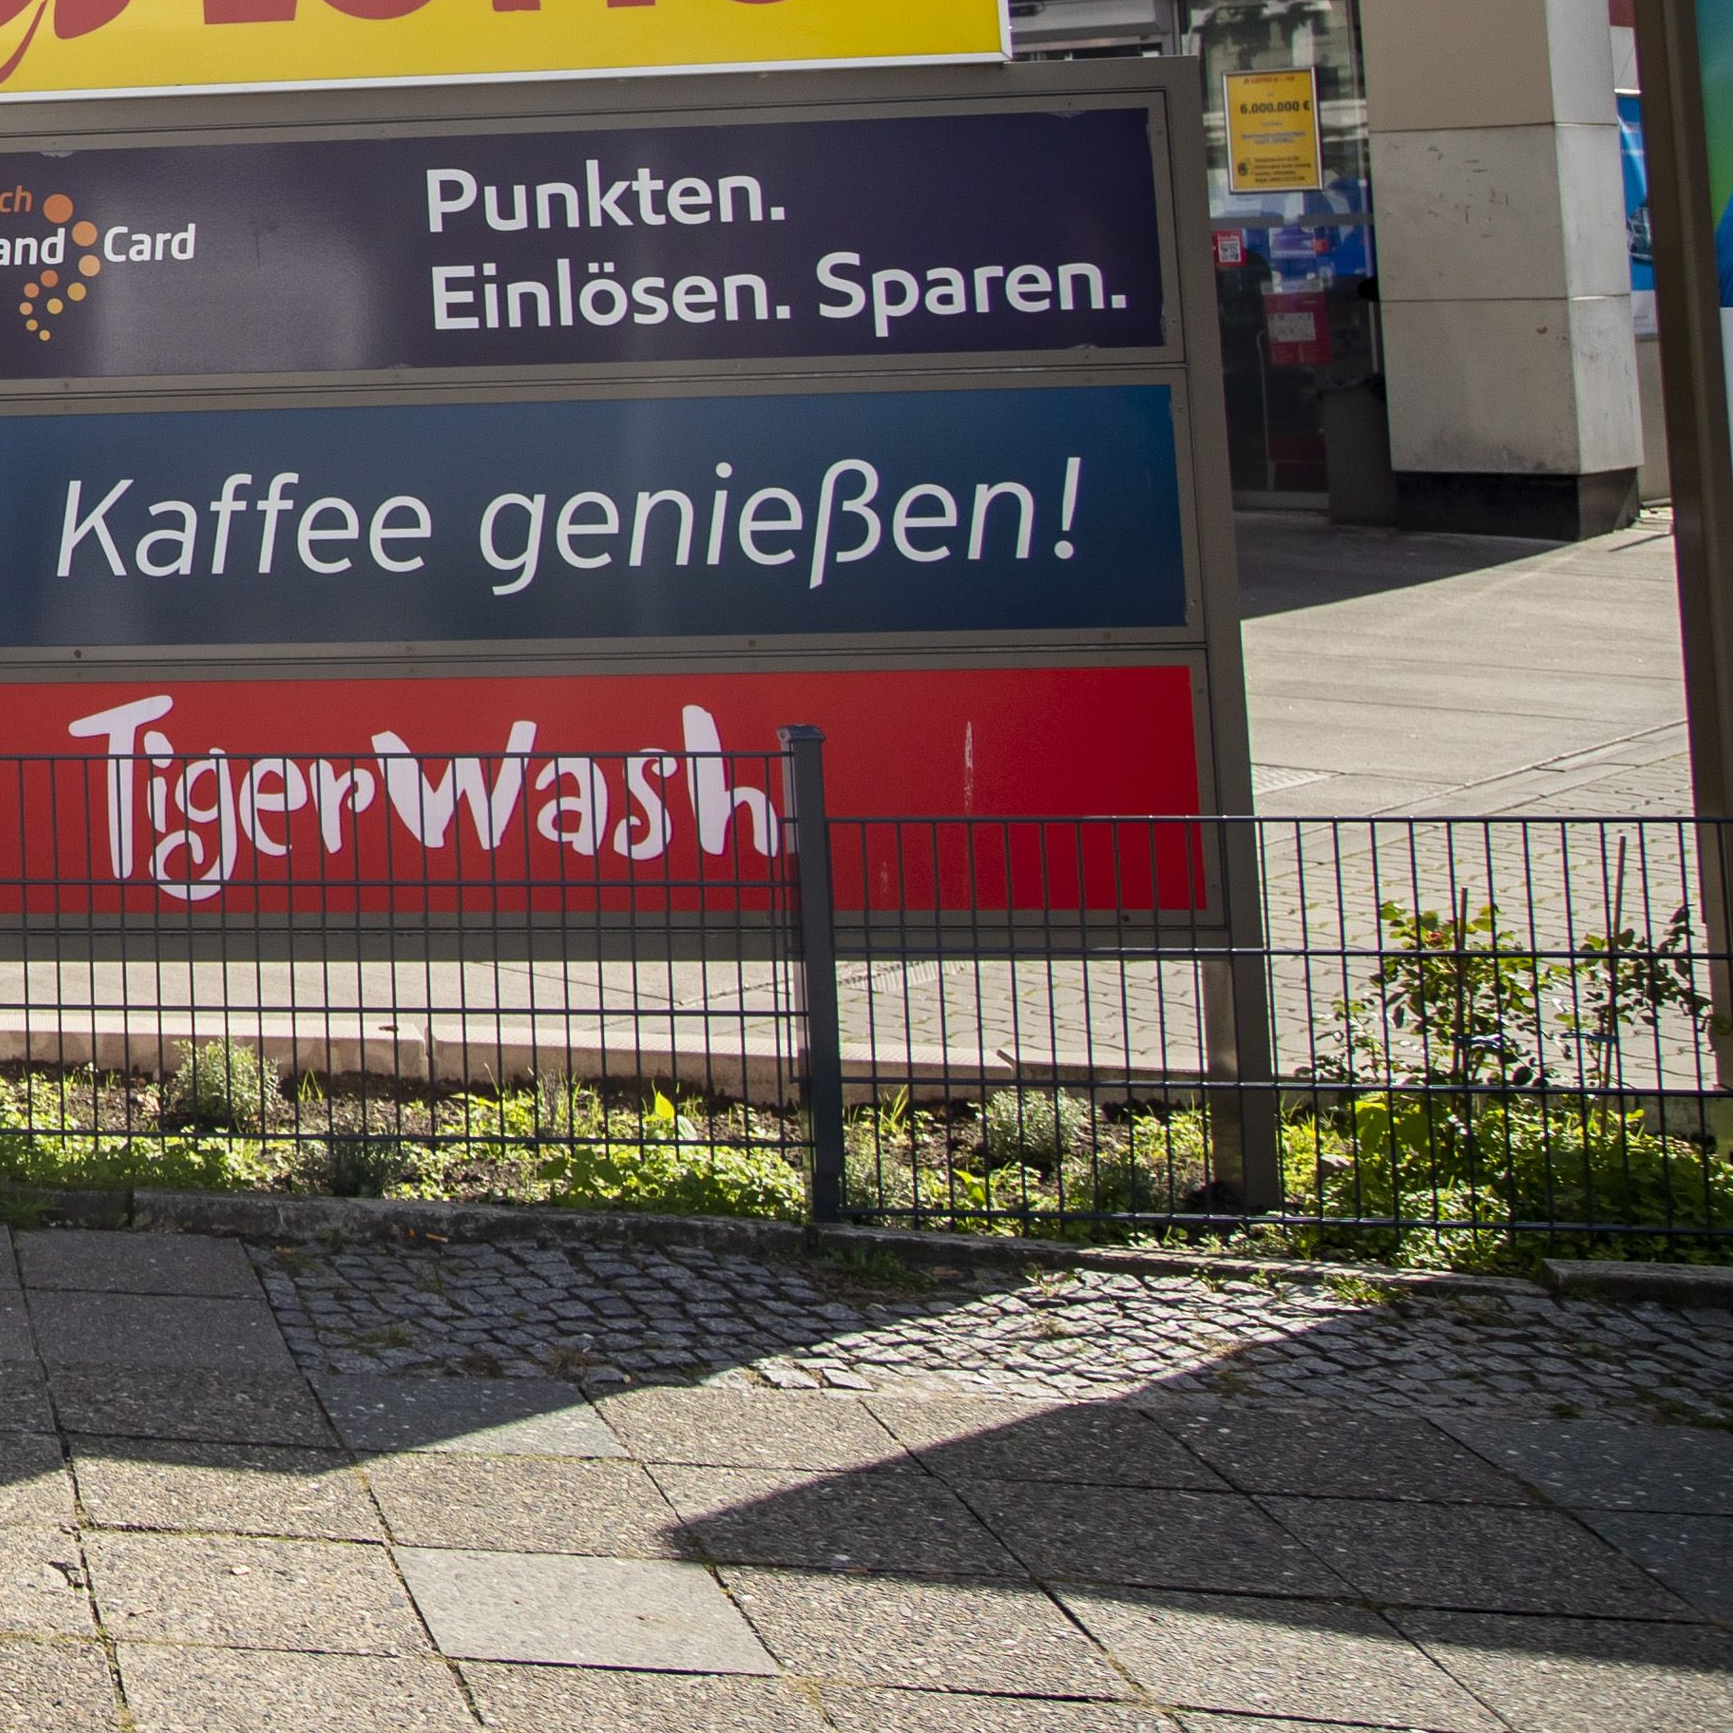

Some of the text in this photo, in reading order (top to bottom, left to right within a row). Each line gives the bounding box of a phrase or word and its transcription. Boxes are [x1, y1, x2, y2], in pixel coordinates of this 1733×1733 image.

[425, 158, 786, 234] Punkten.
[102, 223, 198, 264] Card
[430, 251, 1128, 339] Einlösen. Sparen.
[56, 455, 1083, 598] Kaffee genießen!
[68, 694, 781, 902] TigerWash
